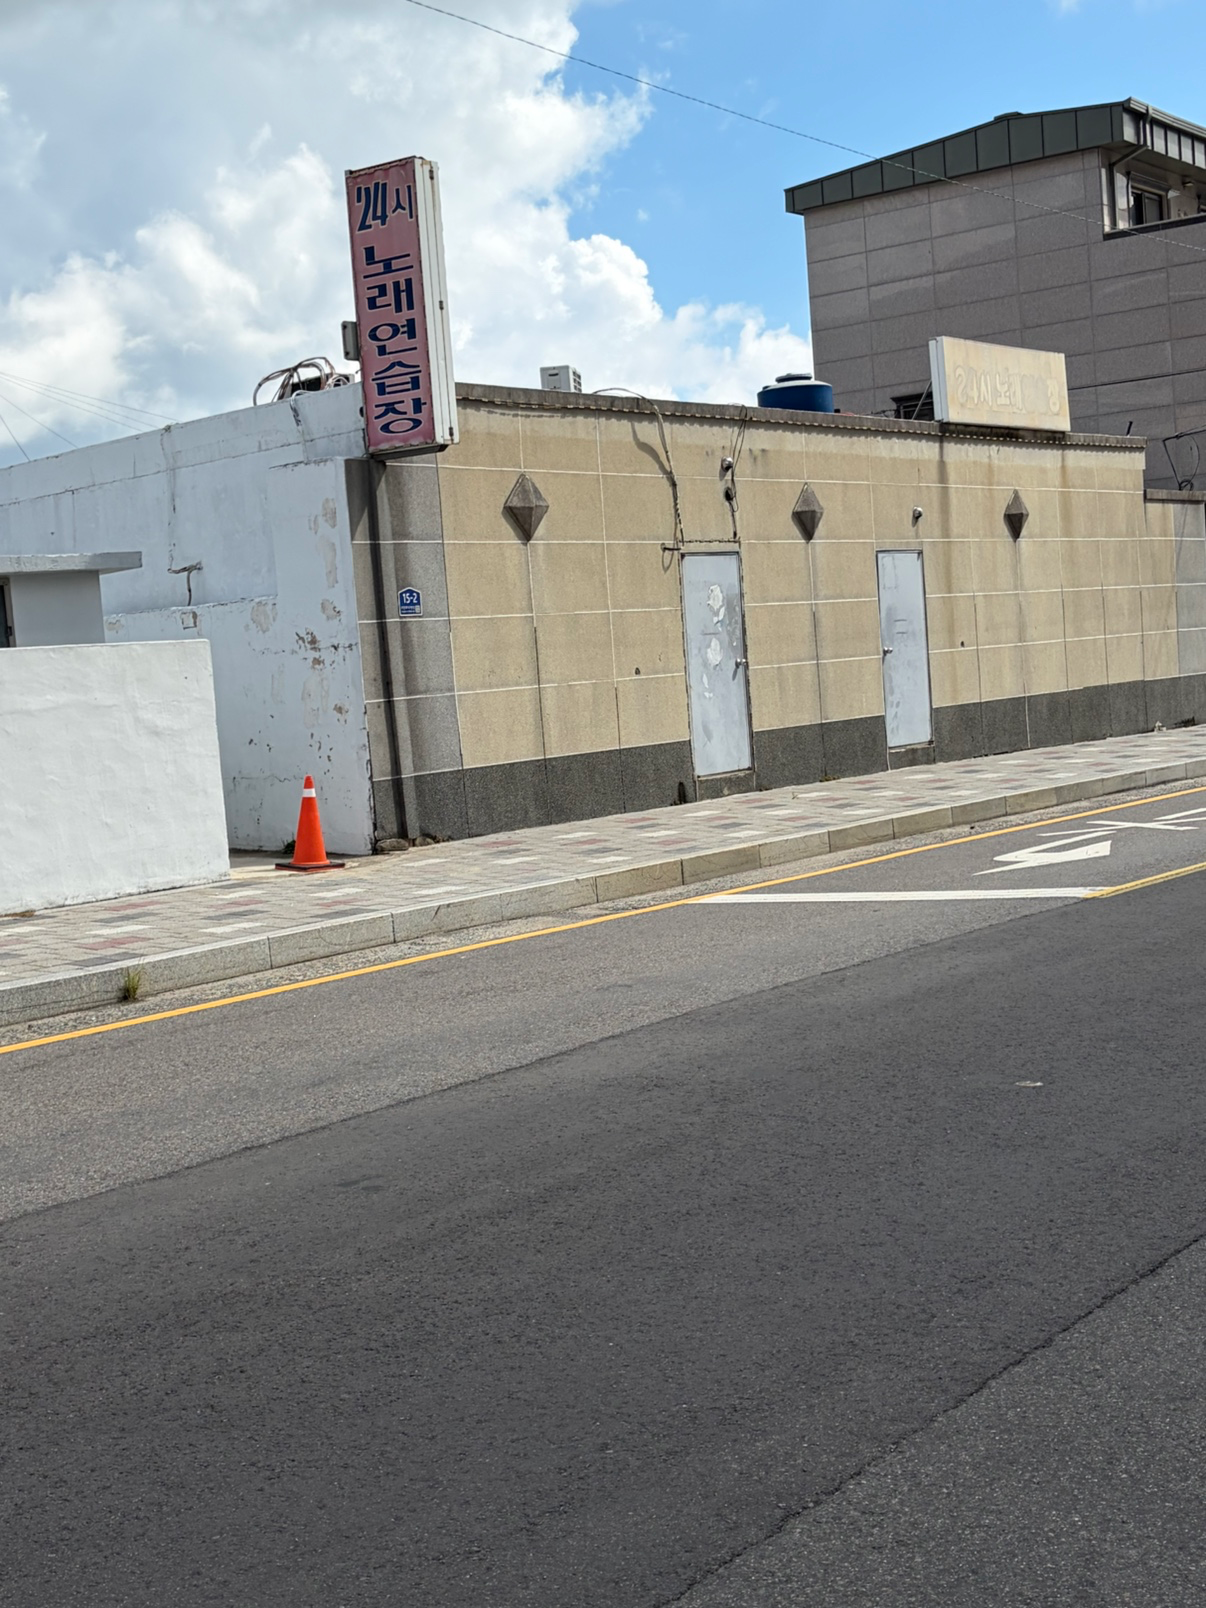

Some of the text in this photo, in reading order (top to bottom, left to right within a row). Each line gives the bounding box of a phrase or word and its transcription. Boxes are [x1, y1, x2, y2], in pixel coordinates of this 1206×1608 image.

[356, 181, 414, 232] 24시
[362, 245, 428, 435] 노래연습장
[402, 592, 418, 604] 15-2
